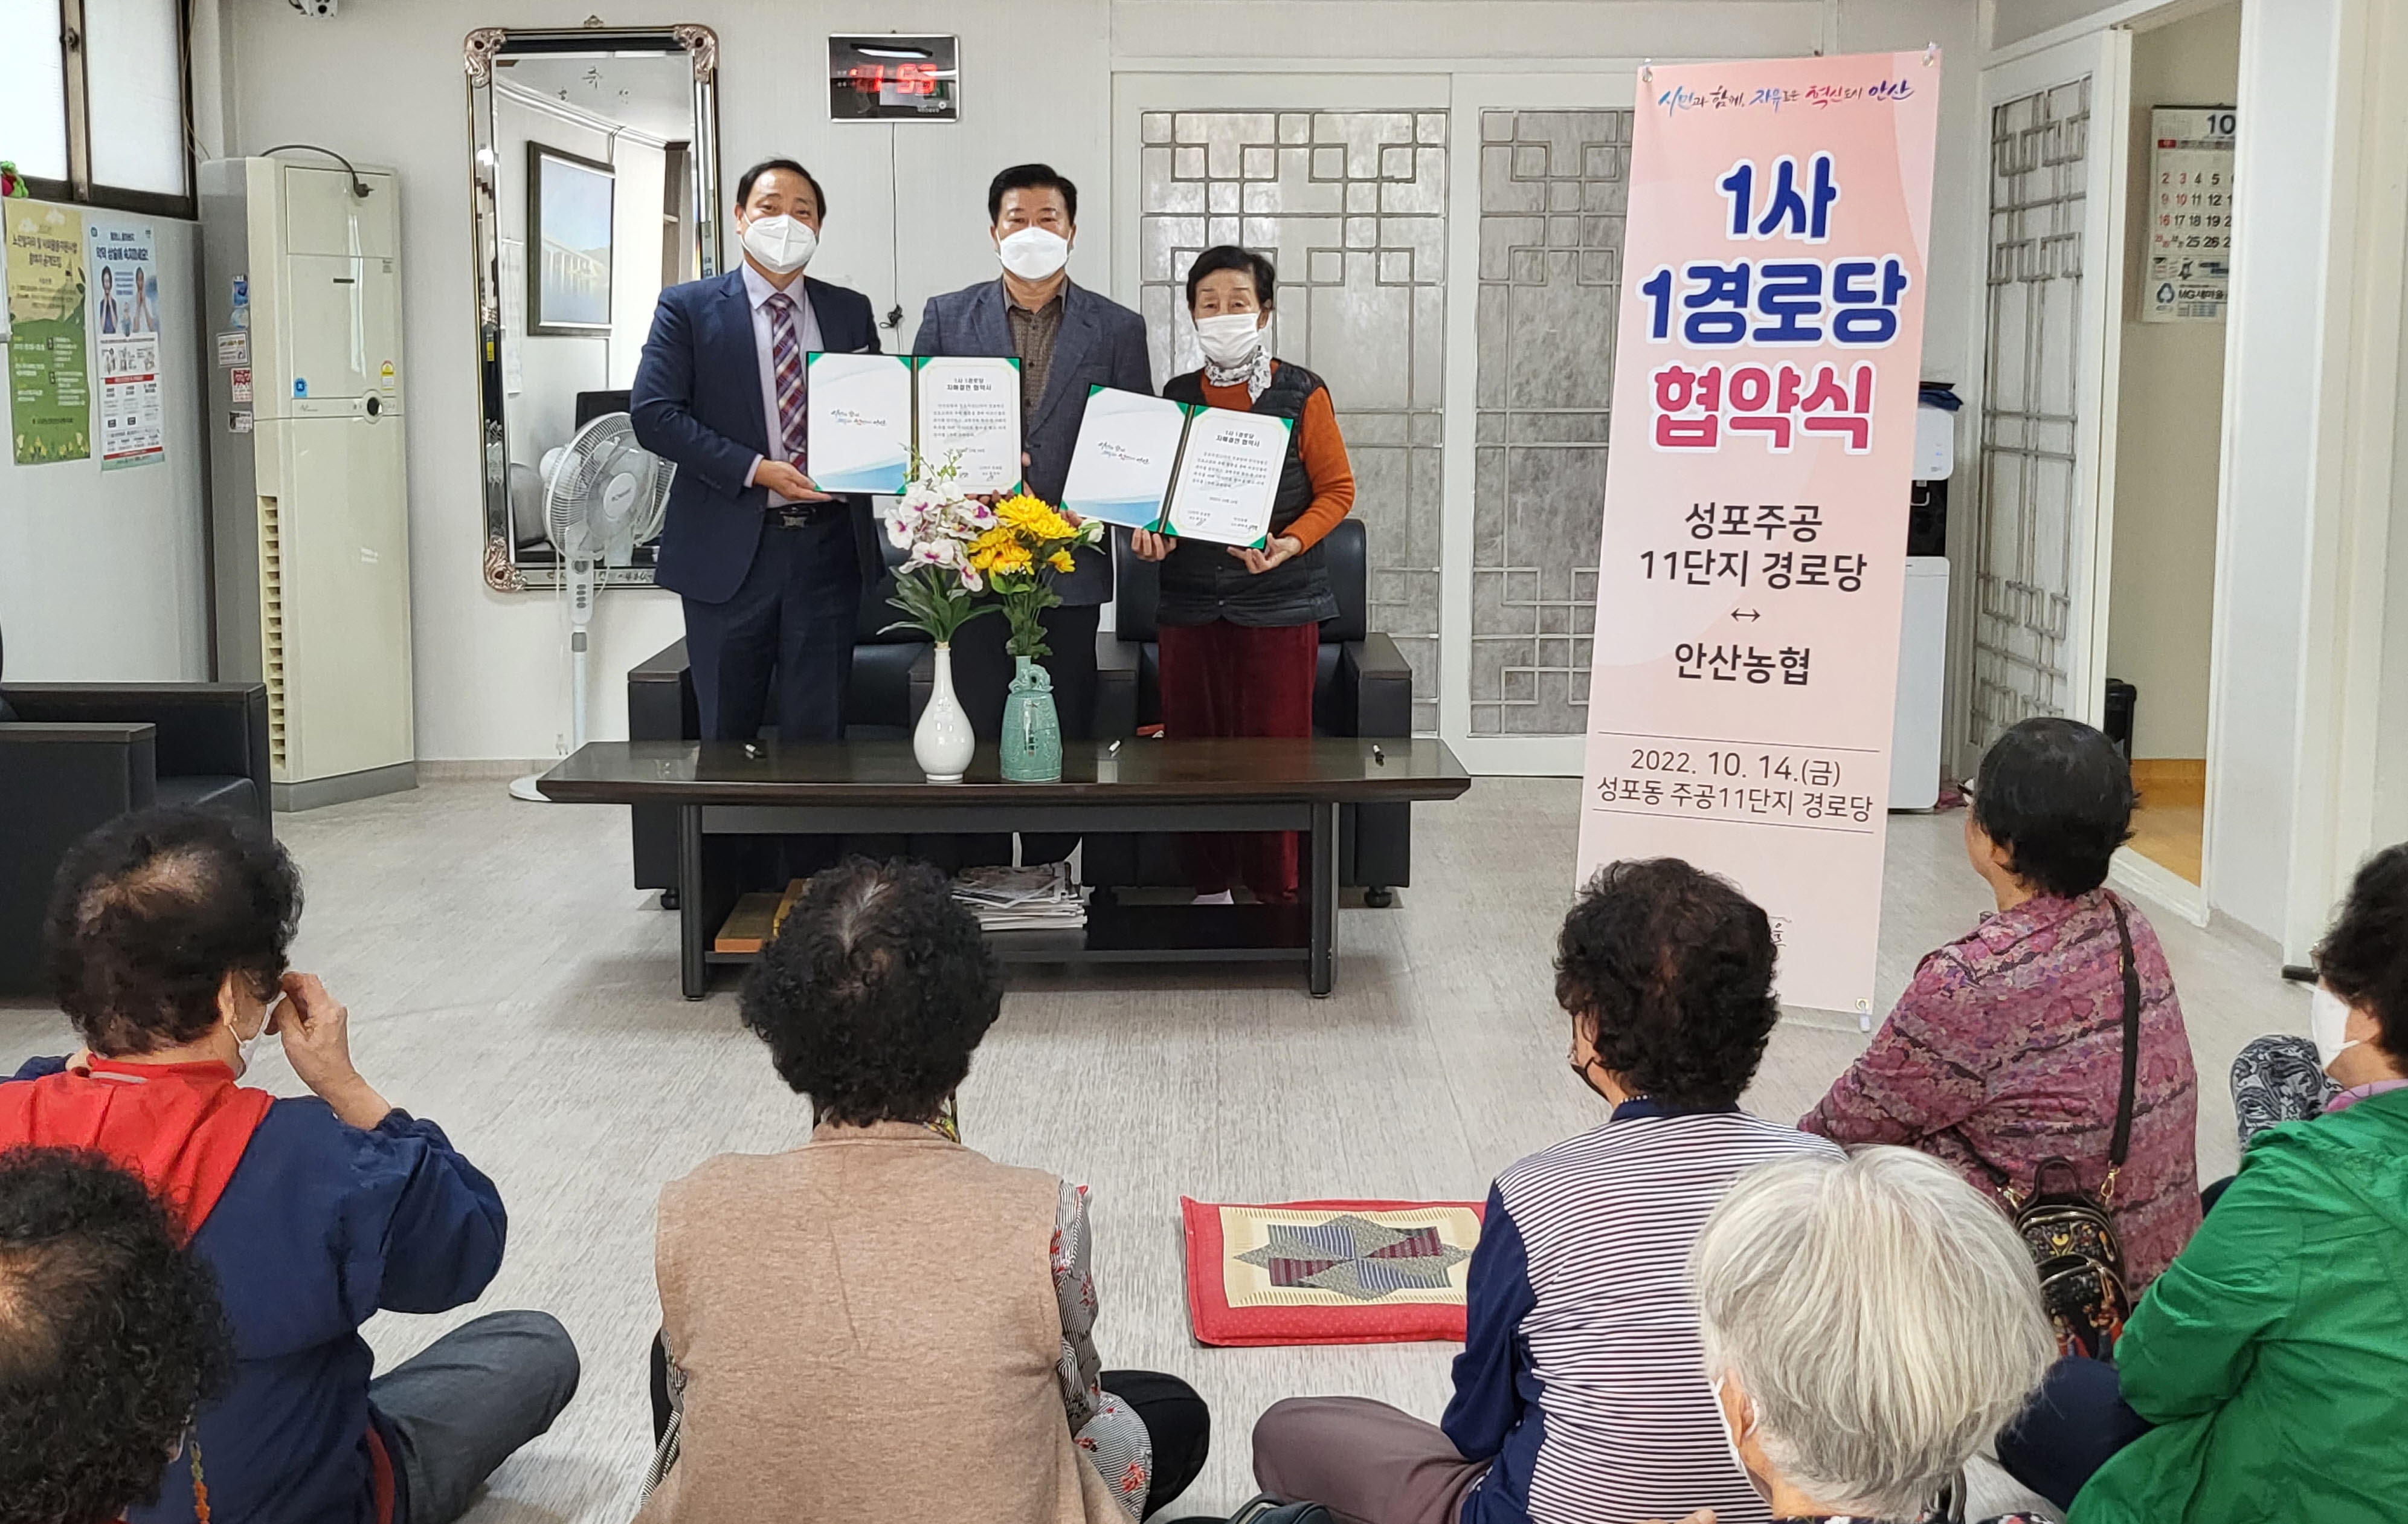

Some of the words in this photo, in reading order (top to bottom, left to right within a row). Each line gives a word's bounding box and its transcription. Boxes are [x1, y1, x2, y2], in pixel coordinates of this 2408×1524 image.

[1657, 85, 1708, 117] 시민과
[1748, 88, 1799, 113] 자유로운
[1804, 85, 1862, 110] 혁신도시
[1867, 79, 1916, 101] 안산
[2207, 114, 2236, 135] 10
[1722, 156, 1837, 239] 1사
[1643, 259, 1907, 344] 1경로당
[2178, 289, 2227, 300] MG새마을
[1654, 364, 1872, 451] 협약식
[1685, 502, 1823, 543] 성포주공
[1640, 549, 1748, 588] 11단지
[1762, 552, 1868, 593] 경로당
[1674, 642, 1811, 687] 안산농협
[1631, 748, 1698, 776] 2022.
[1707, 751, 1748, 778] 10.
[1758, 755, 1841, 788] 14.(금)
[1597, 777, 1664, 806] 성포동
[1670, 784, 1794, 817] 주공11단지
[1801, 790, 1873, 823] 경로당
